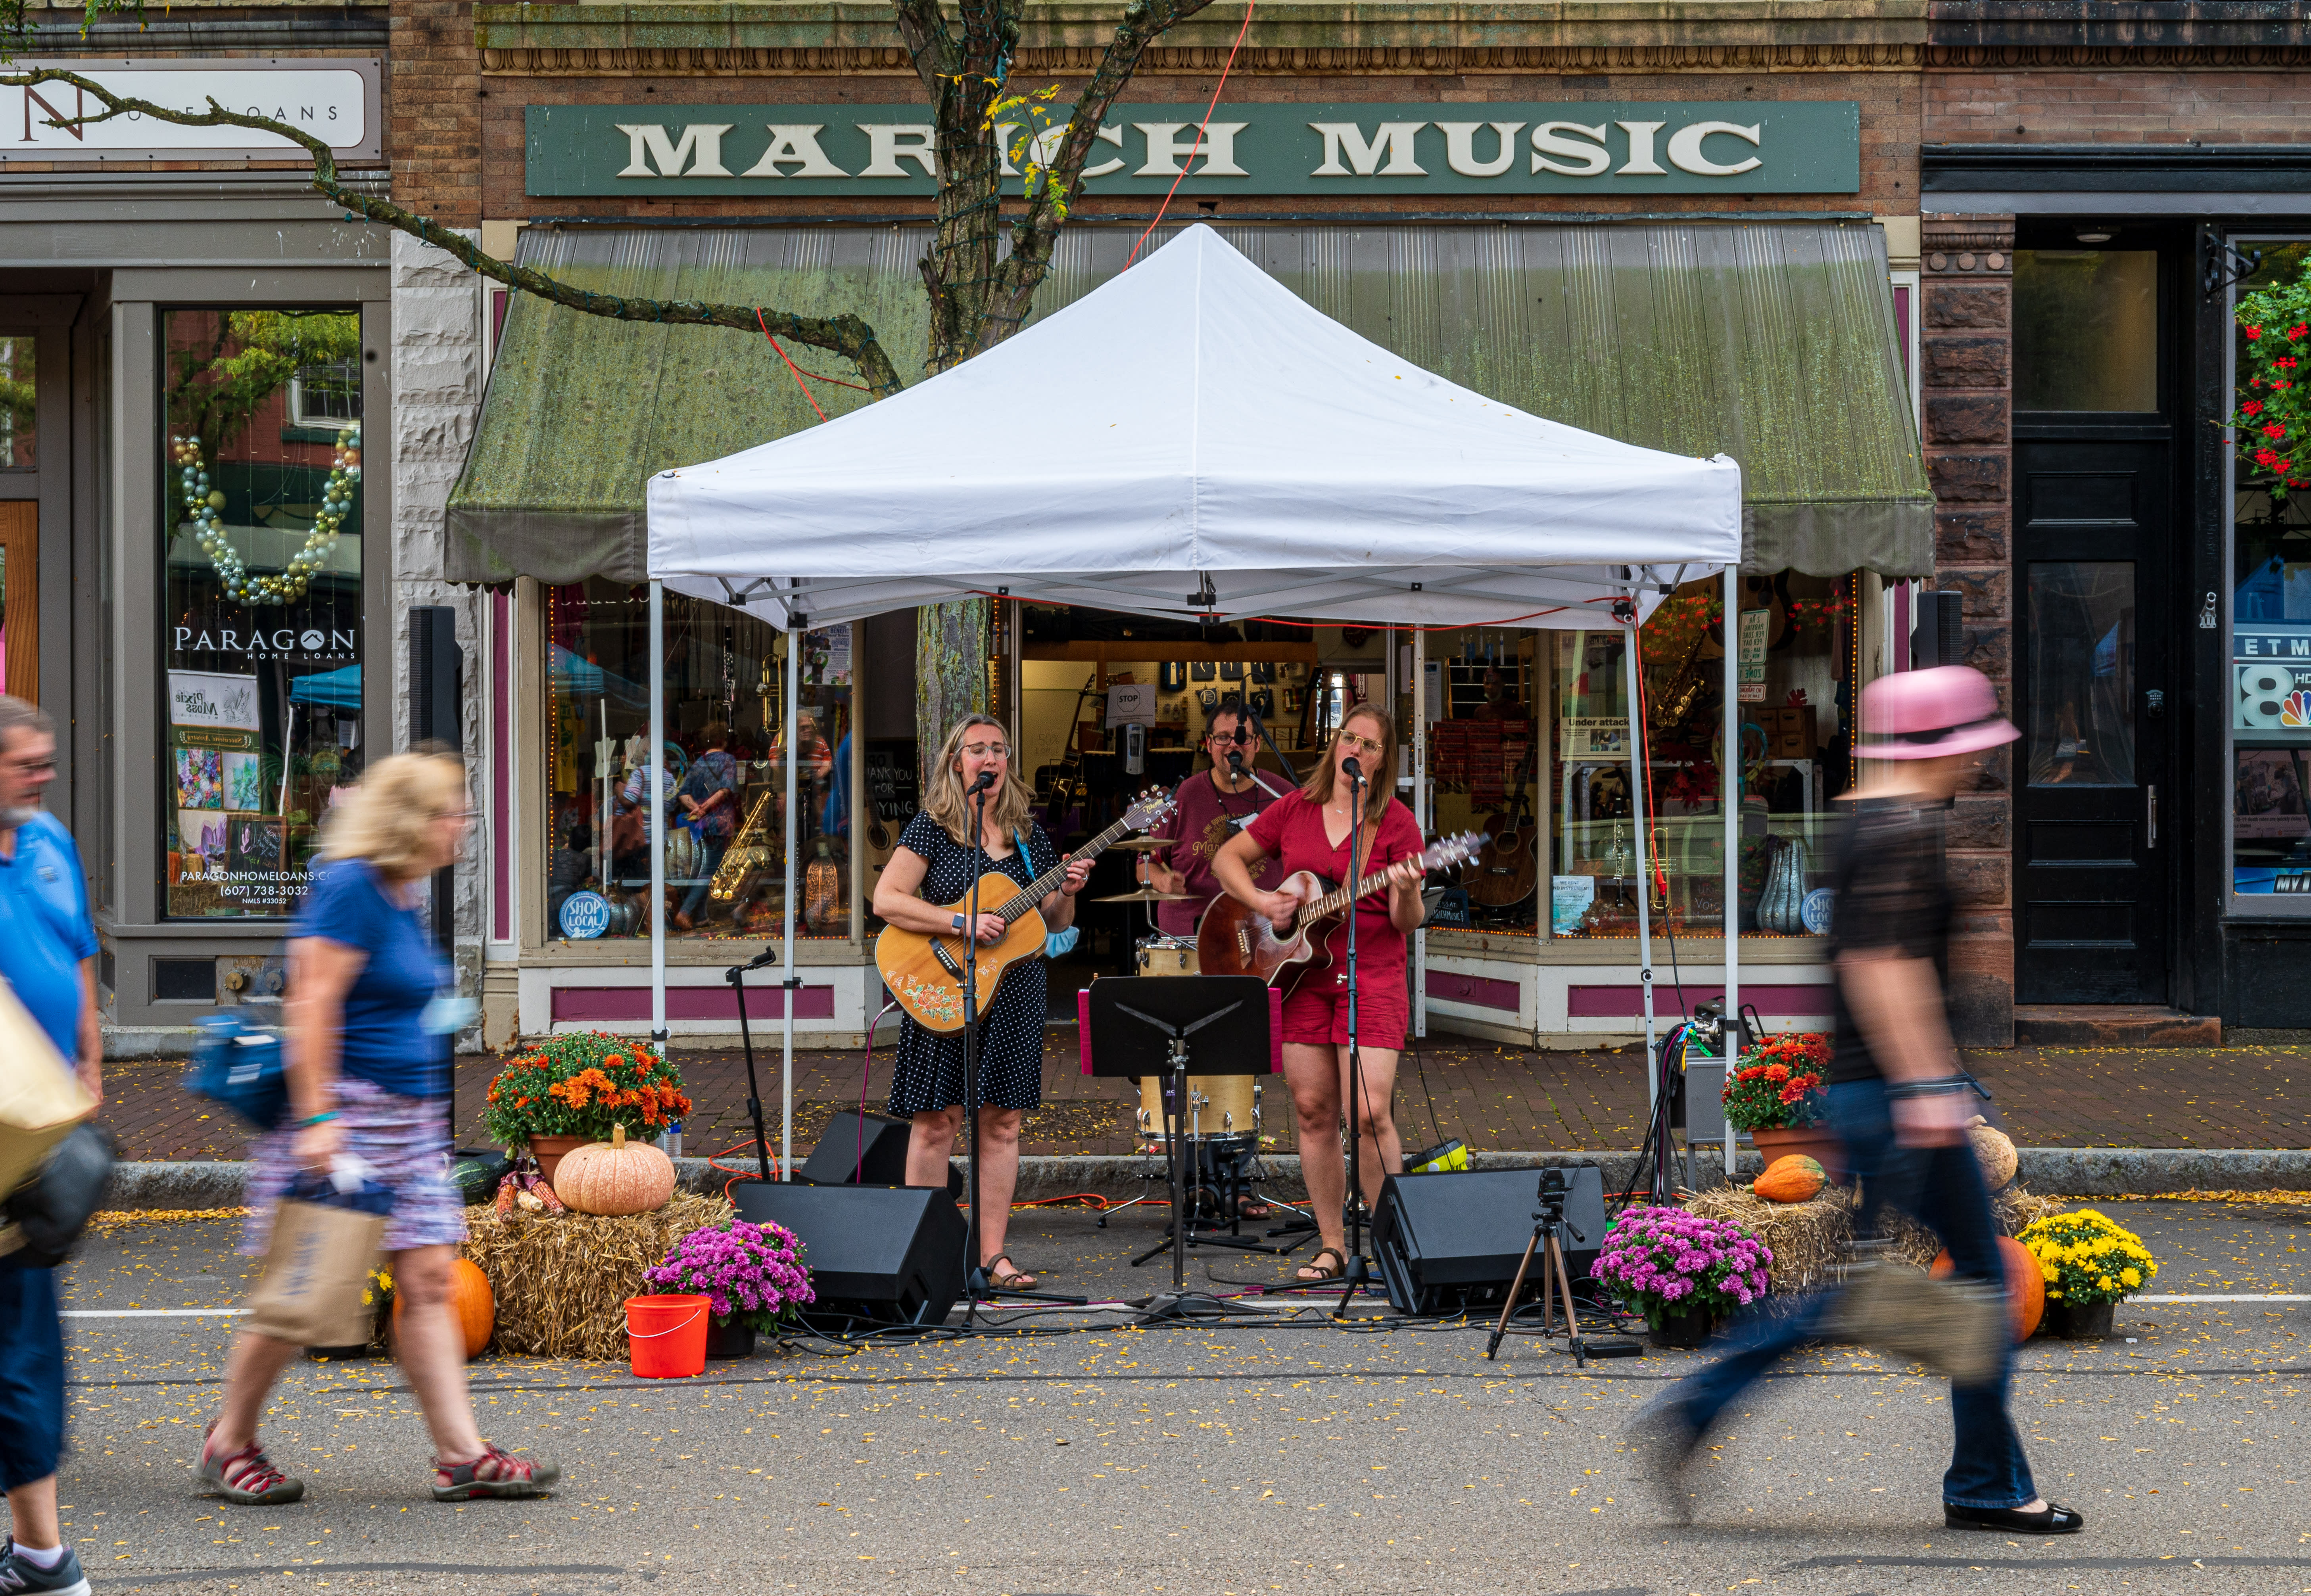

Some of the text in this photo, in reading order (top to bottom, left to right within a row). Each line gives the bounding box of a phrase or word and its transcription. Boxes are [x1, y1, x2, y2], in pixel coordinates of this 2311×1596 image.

[1307, 121, 1763, 177] MUSIC
[174, 627, 355, 650] PARAGON
[2245, 638, 2309, 656] ETM
[2241, 666, 2294, 727] 8
[1599, 718, 1630, 727] attack
[868, 767, 912, 781] ANK YOU
[875, 783, 895, 794] FOR
[1203, 823, 1212, 834] FINE
[1211, 814, 1230, 825] GUITARS
[1192, 839, 1219, 856] Mar
[221, 885, 308, 897] (607) 738-3032
[569, 901, 601, 916] SHOP
[1810, 898, 1832, 912] SHO
[569, 915, 601, 928] LOCAL
[1811, 912, 1829, 922] LOC
